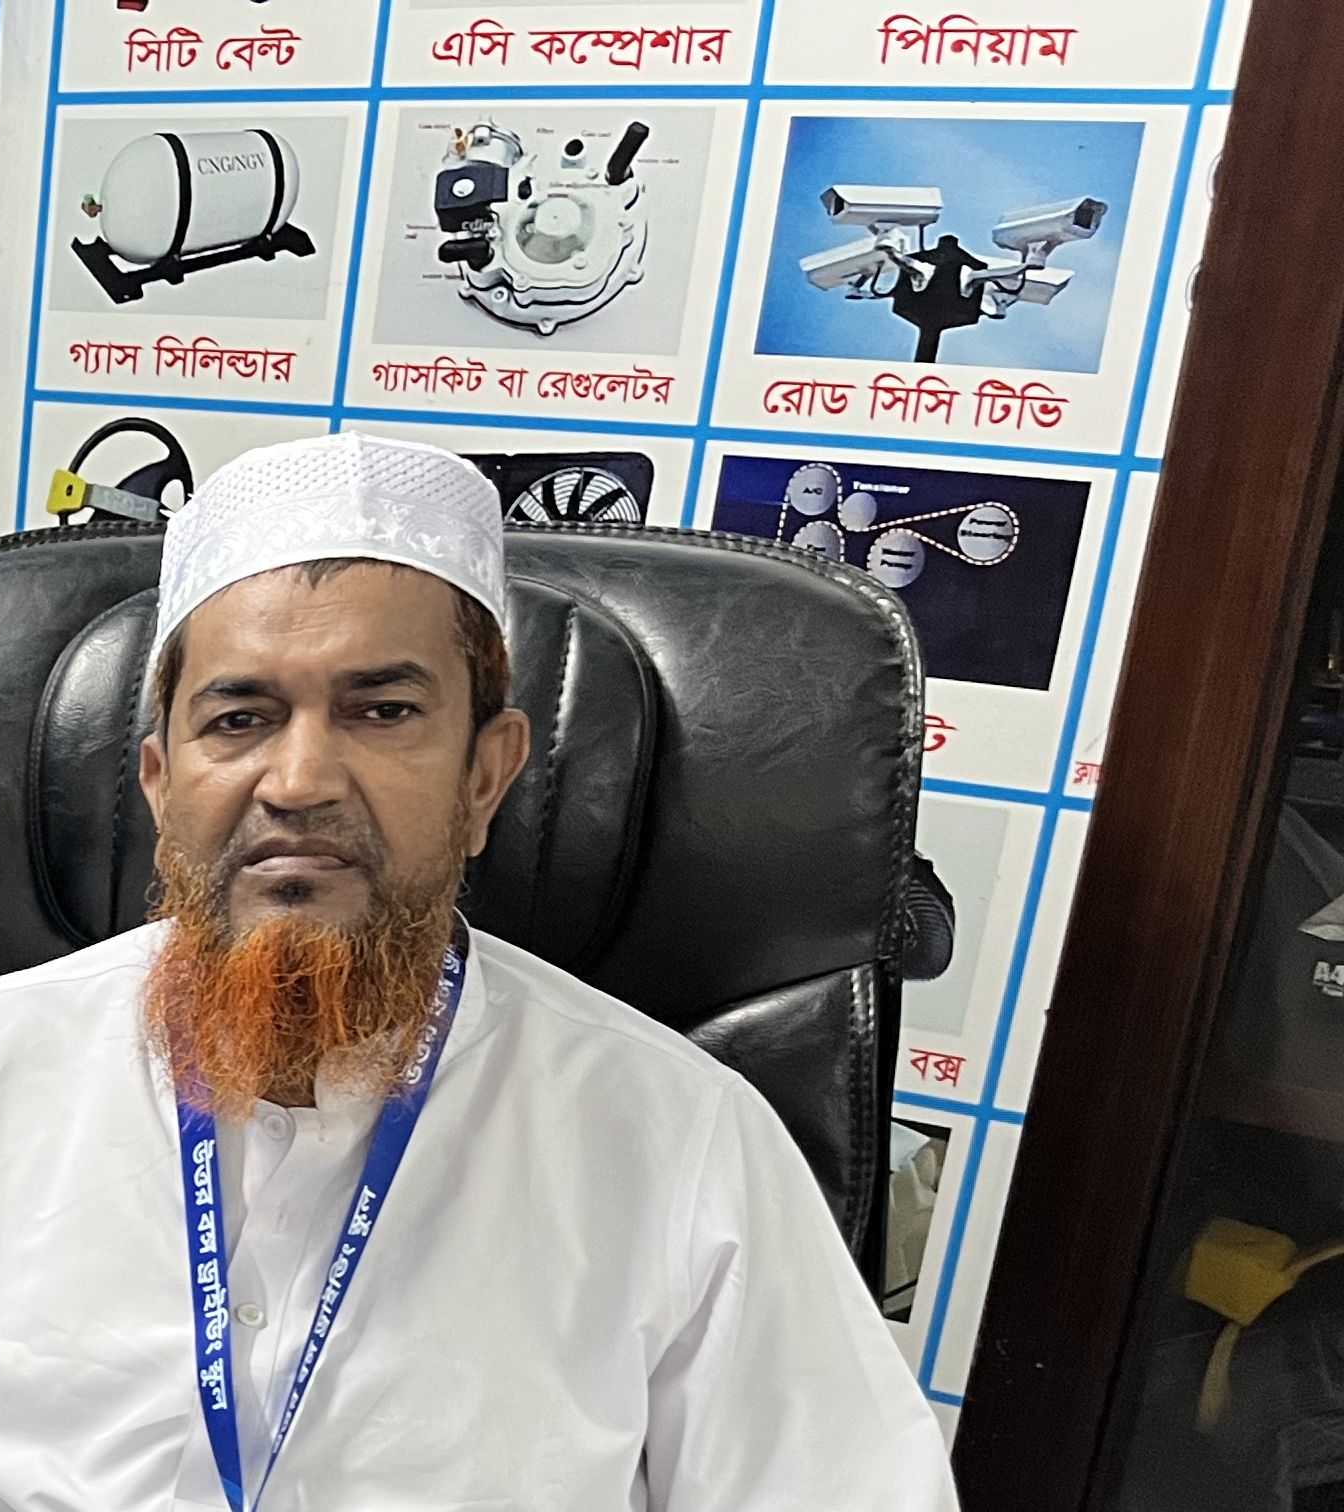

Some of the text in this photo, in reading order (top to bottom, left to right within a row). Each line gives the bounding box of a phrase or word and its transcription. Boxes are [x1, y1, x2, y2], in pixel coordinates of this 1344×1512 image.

[123, 24, 301, 73] সিটি বেল্ট
[432, 19, 731, 71] এসি কম্প্রেশার
[876, 14, 1078, 66] পিনিয়াম
[69, 335, 297, 383] গ্যাস সিলিন্ডার
[372, 355, 676, 405] গ্যাসকিট বা রেগুলেটর
[762, 372, 1069, 430] রোড সিসি টিভি
[909, 1048, 967, 1087] বক্স
[191, 1139, 216, 1206] উত্তর
[196, 1258, 229, 1354] ড্রাইভিং
[199, 1358, 228, 1410] স্কুল
